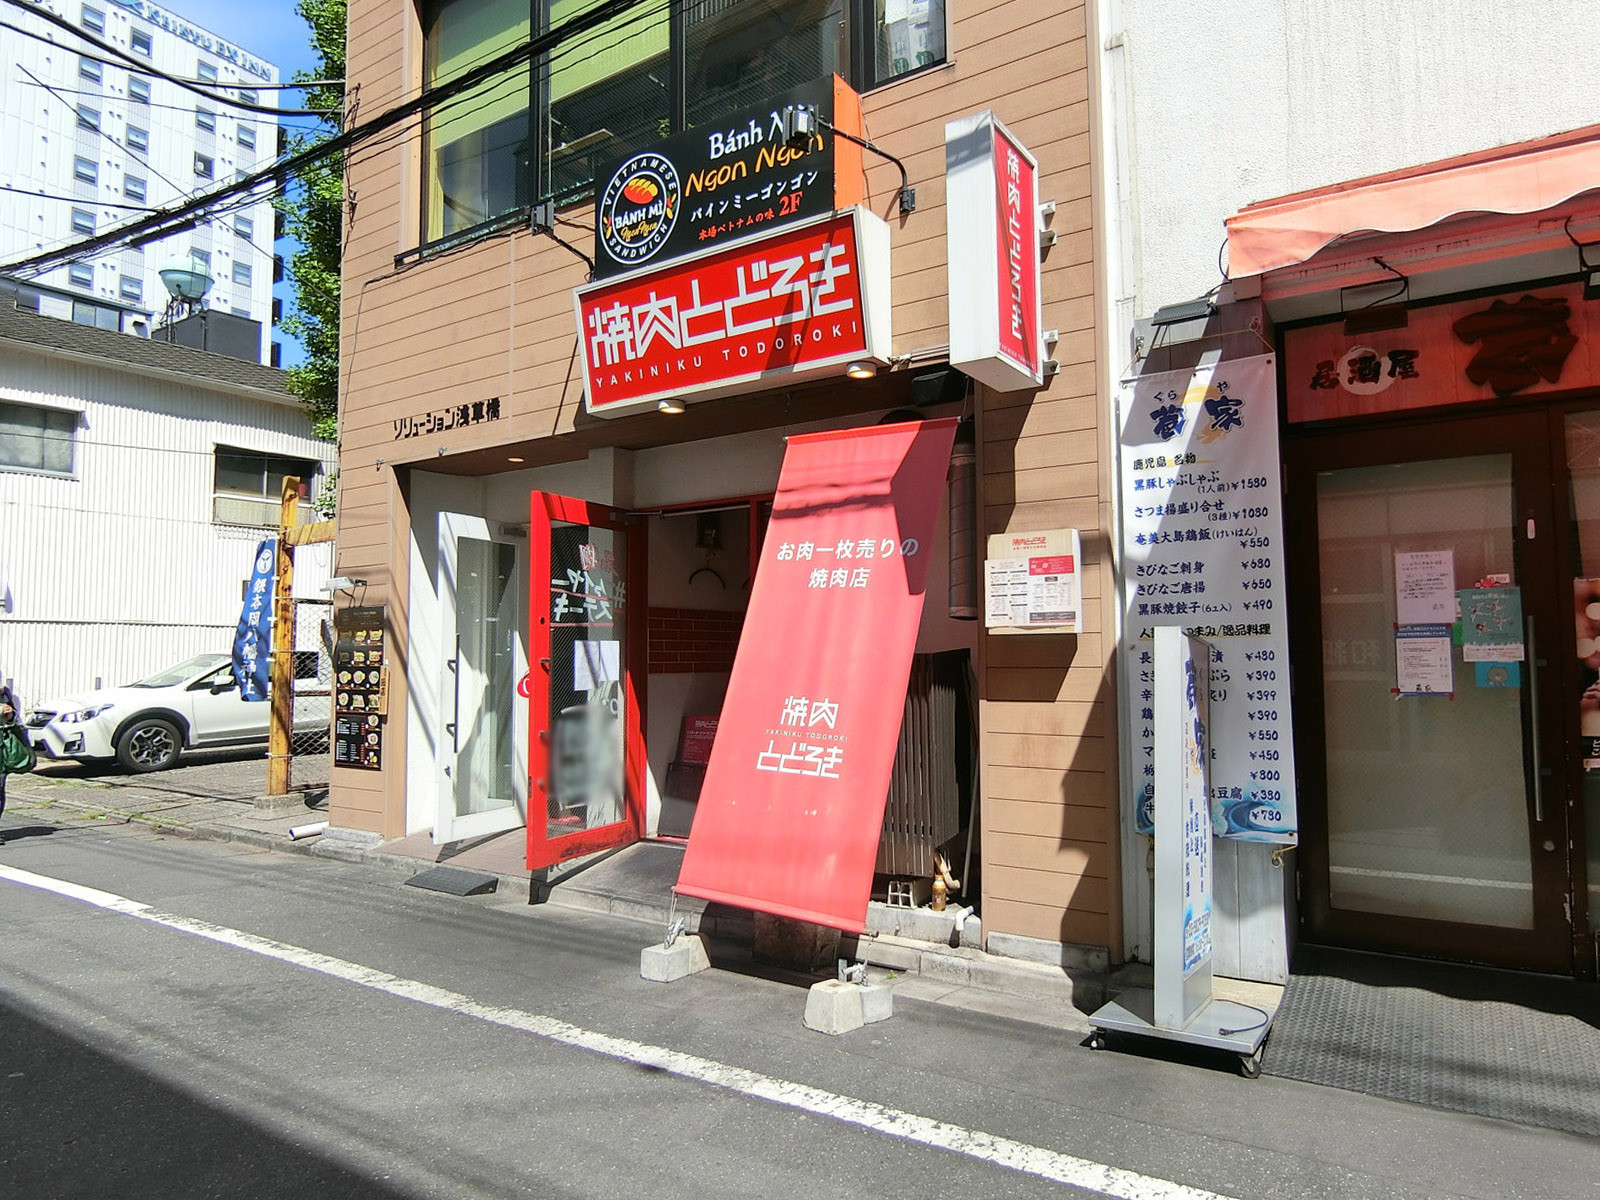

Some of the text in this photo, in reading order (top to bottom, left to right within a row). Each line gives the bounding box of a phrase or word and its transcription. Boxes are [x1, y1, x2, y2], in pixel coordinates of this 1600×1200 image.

[147, 5, 272, 81] KEIKYU EX INN
[709, 117, 763, 160] Bánh
[604, 158, 677, 206] VIETNAMESE
[684, 160, 748, 197] Ngon
[615, 207, 646, 229] BÁNH
[698, 191, 804, 241] 本場ベトナムの味 2F
[609, 223, 668, 258] SANDWICH
[1007, 147, 1022, 340] 焼肉とどろき
[588, 242, 853, 368] 焼肉とどろき
[595, 320, 857, 388] YAKINIKU TODOROKI
[1310, 349, 1420, 391] 居酒屋
[1153, 380, 1231, 402] くら や
[394, 397, 500, 440] ソリューション浅草橋
[1132, 454, 1197, 471] 鹿児島 名物
[1134, 471, 1220, 491] 黒豚しゃぶしゃぶ
[1134, 499, 1225, 518] さつま揚盛り合せ
[776, 538, 919, 561] お肉一枚売りの
[1239, 537, 1270, 549] ¥550
[808, 567, 871, 589] 焼肉店
[1136, 558, 1271, 577] きびなご刺身 ¥680
[1136, 578, 1272, 596] きびなご唐揚 ¥650
[1243, 599, 1273, 611] ¥490
[239, 577, 267, 694] 銀杏岡八幡神社
[1245, 650, 1275, 662] ¥480
[1246, 670, 1276, 682] ¥390
[1246, 690, 1277, 701] ¥399
[780, 695, 839, 729] 焼肉
[1247, 710, 1278, 721] ¥390
[765, 728, 849, 742] YAKINIKU TODOROKI
[1249, 730, 1279, 741] ¥550
[756, 739, 844, 779] とどろき
[1249, 750, 1280, 761] ¥450
[1250, 769, 1280, 781] ¥800
[1251, 789, 1281, 801] ¥380
[1251, 809, 1282, 822] ¥780
